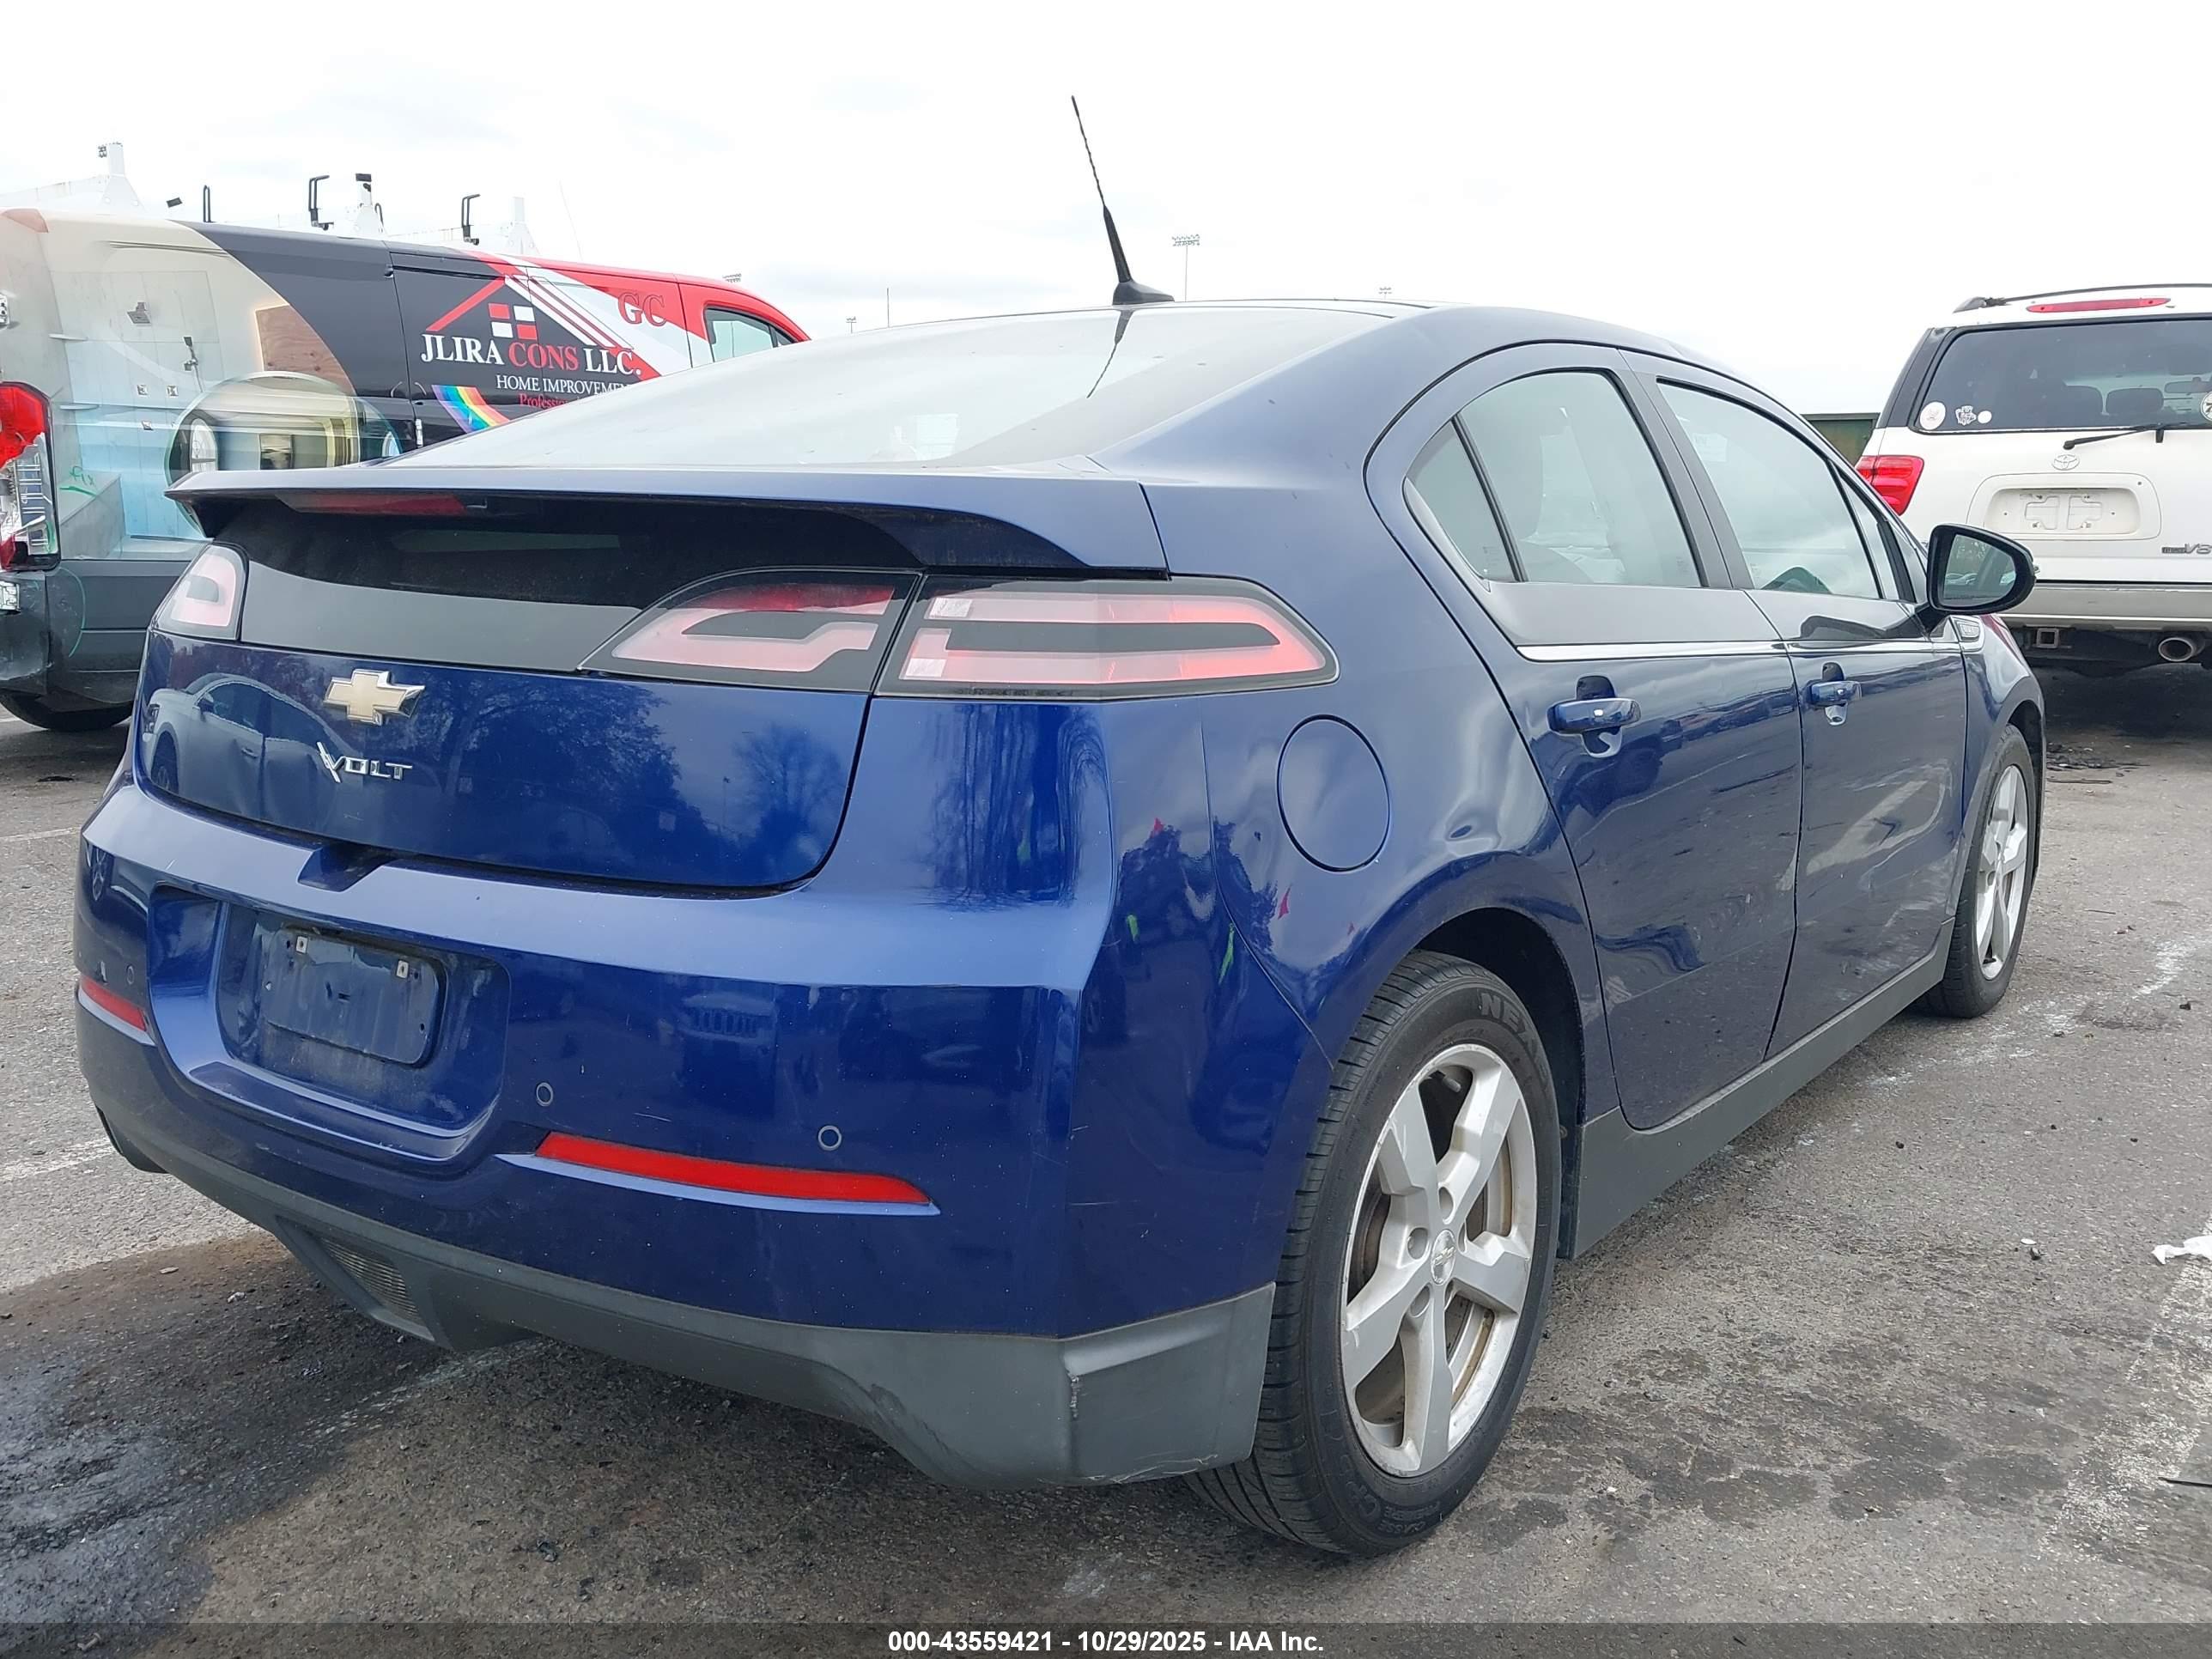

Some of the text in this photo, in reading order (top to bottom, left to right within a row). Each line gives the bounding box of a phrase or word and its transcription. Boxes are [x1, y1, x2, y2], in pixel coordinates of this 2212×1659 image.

[618, 292, 667, 327] GC
[421, 333, 641, 376] JLIRA CONS LLC.
[496, 374, 540, 392] HOME
[317, 741, 412, 783] VOLT
